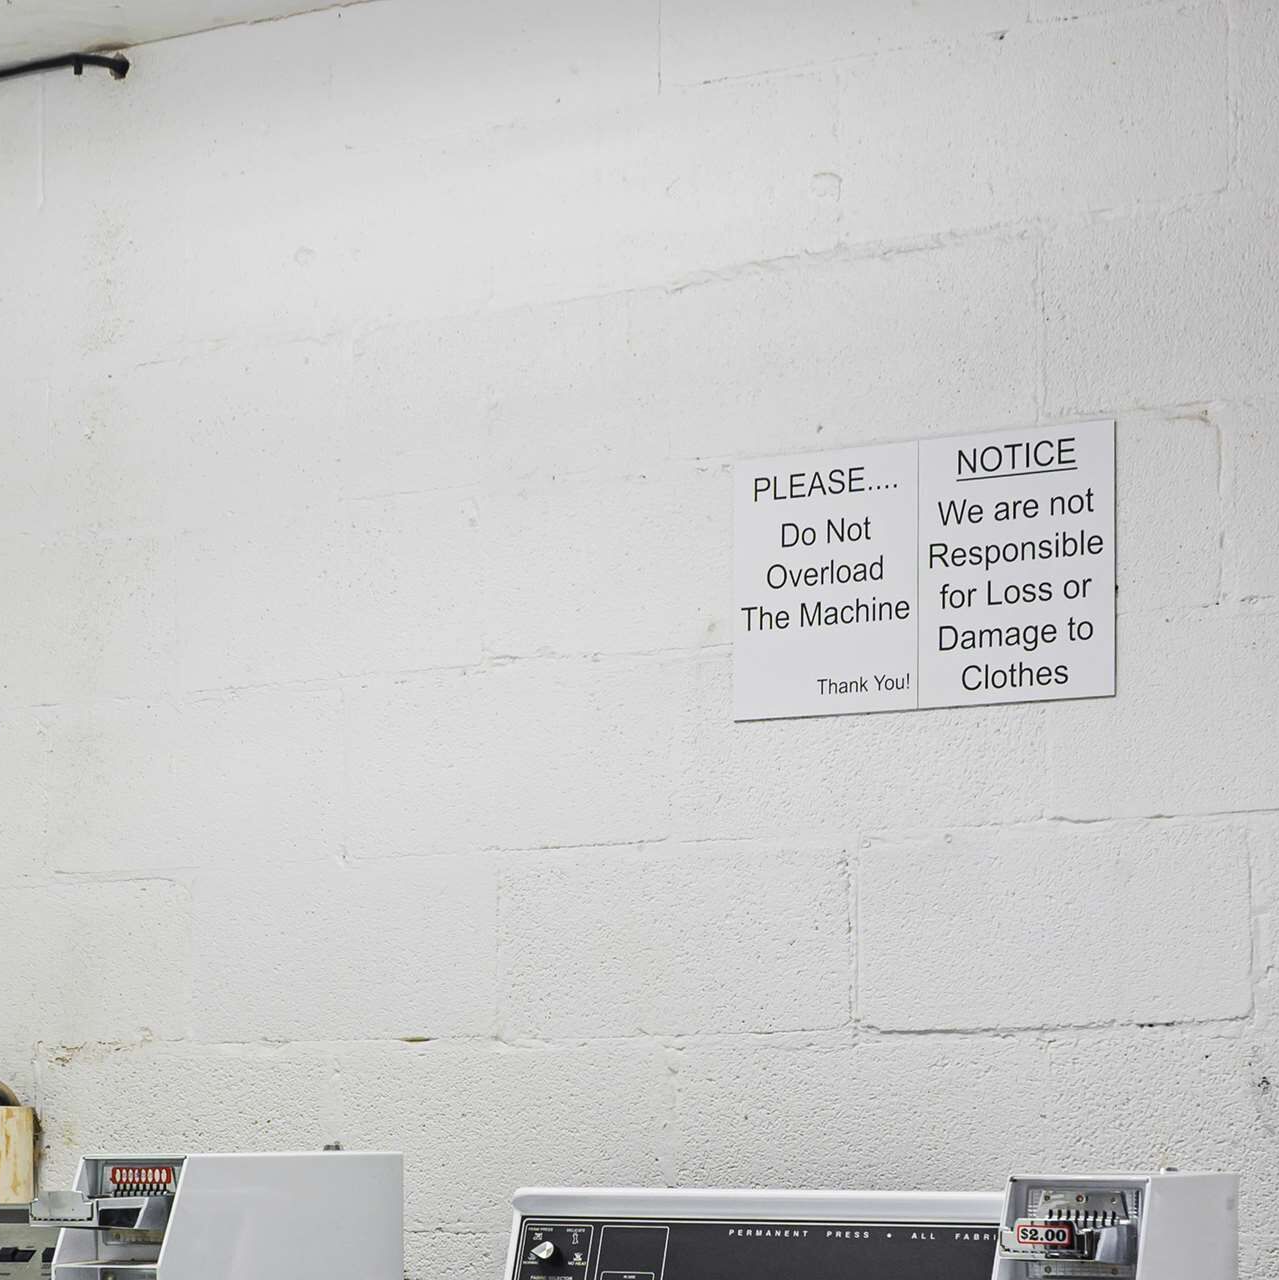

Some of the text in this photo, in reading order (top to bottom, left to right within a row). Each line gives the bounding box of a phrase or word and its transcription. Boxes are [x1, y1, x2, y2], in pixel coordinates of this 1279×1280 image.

[957, 437, 1077, 478] NOTICE
[753, 467, 898, 501] PLEASE....
[938, 488, 1093, 526] We are not
[781, 516, 871, 547] Do Not
[928, 530, 1104, 571] Responsible
[767, 555, 884, 588] Overload
[940, 576, 1092, 610] for Loss or
[741, 598, 910, 631] The Machine
[938, 615, 1093, 652] Damage to
[817, 673, 910, 695] Thank You!
[962, 662, 1068, 691] Clothes
[729, 1229, 809, 1238] PERMANENT
[827, 1230, 870, 1239] PRESS
[911, 1232, 936, 1241] ALL
[1020, 1228, 1067, 1242] $2.00
